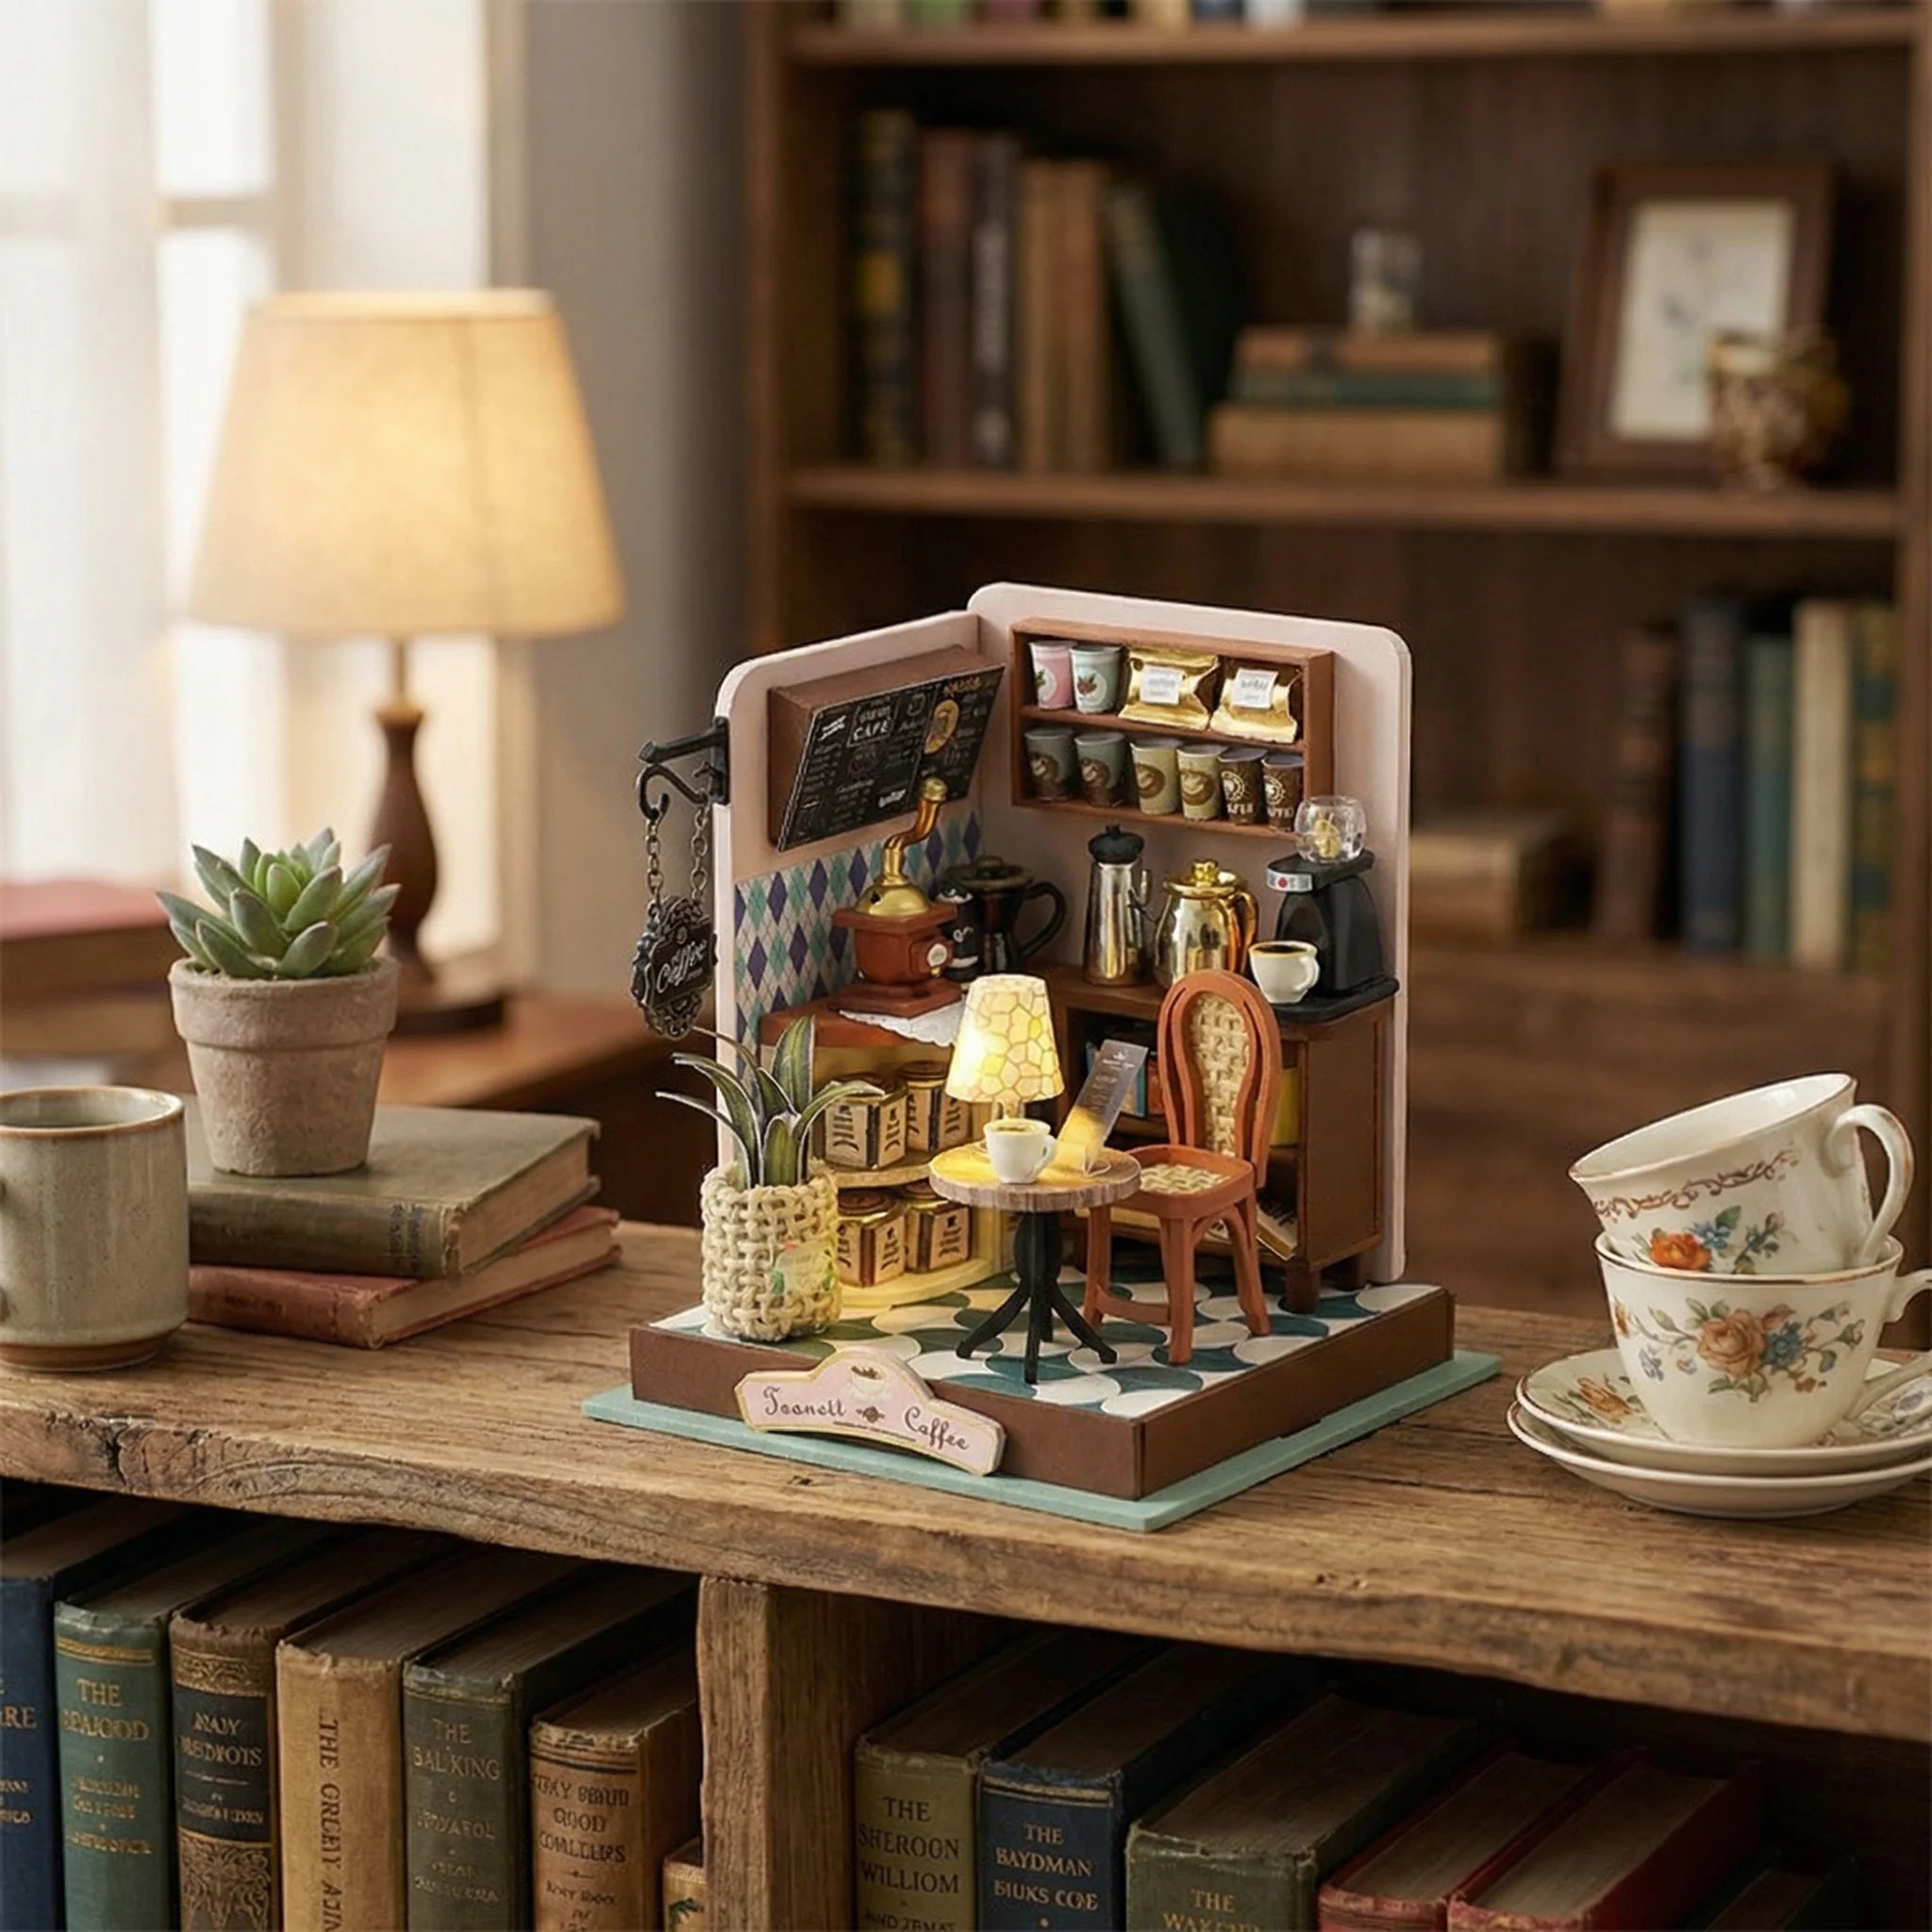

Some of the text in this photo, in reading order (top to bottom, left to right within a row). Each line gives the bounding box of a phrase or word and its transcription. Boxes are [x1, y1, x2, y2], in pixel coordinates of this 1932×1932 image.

[76, 1678, 122, 1707] THE
[319, 1719, 340, 1769] THE
[432, 1718, 473, 1744] THE
[883, 1796, 932, 1823] THE
[1024, 1823, 1064, 1845] THE
[1191, 1888, 1235, 1913] THE
